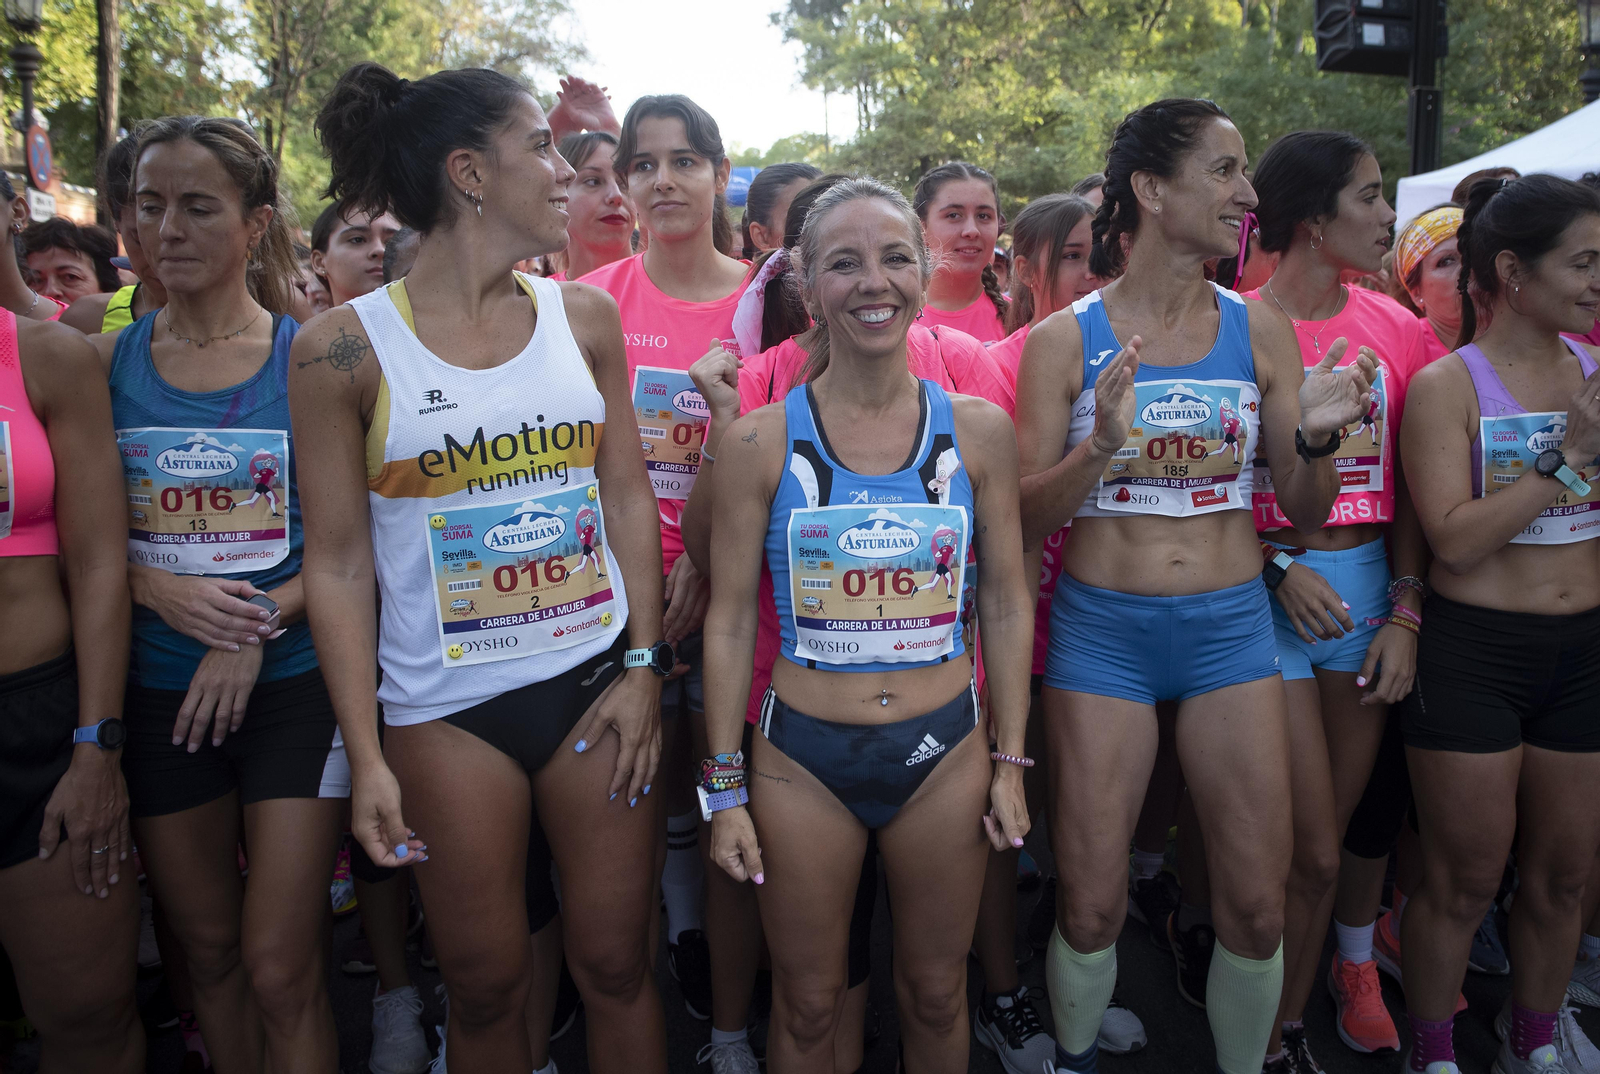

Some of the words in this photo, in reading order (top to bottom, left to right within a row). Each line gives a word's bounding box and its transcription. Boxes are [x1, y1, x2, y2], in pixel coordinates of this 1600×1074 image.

[623, 333, 668, 348] YSHO
[643, 387, 667, 396] SUMA
[1146, 408, 1207, 421] ASTURIANA
[673, 423, 707, 447] 01
[418, 414, 595, 478] eMotion
[1147, 436, 1206, 460] 016
[123, 449, 149, 458] SUMA
[161, 455, 233, 470] ASTURIANA
[655, 463, 689, 473] CARRERA
[1335, 458, 1357, 467] MUJER
[467, 460, 568, 495] running
[1131, 478, 1168, 487] CARRERA
[1170, 479, 1181, 487] DE
[1188, 478, 1213, 487] MUJER
[160, 487, 234, 513] 016
[870, 495, 903, 504] Asioka
[1553, 507, 1563, 515] DE
[1565, 507, 1572, 515] LA
[189, 519, 207, 531] 13
[502, 526, 530, 534] CENTRAL
[533, 520, 558, 529] LECHERA
[150, 533, 187, 543] CARRERA
[190, 534, 201, 543] DE
[204, 534, 216, 542] LA
[220, 532, 251, 541] MUJER
[442, 530, 473, 541] SUMA
[490, 525, 562, 547] ASTURIANA
[800, 529, 829, 539] SUMA
[843, 534, 915, 550] ASTURIANA
[136, 550, 178, 564] OYSHO
[226, 551, 275, 562] Santander
[493, 555, 567, 593] 016
[842, 568, 915, 597] 016
[531, 595, 540, 609] 2
[480, 615, 525, 629] CARRERA
[528, 612, 540, 622] DE
[543, 608, 555, 619] LA
[557, 600, 586, 615] MUJER
[876, 604, 883, 617] 1
[566, 616, 602, 635] Santand
[826, 621, 868, 631] CARRERA
[872, 621, 883, 630] DE
[886, 620, 897, 630] LA
[900, 618, 930, 629] MUJER
[460, 636, 518, 654] OYSHO
[808, 638, 860, 654] OYSHO
[906, 637, 946, 650] Santande
[906, 743, 945, 766] adidas
